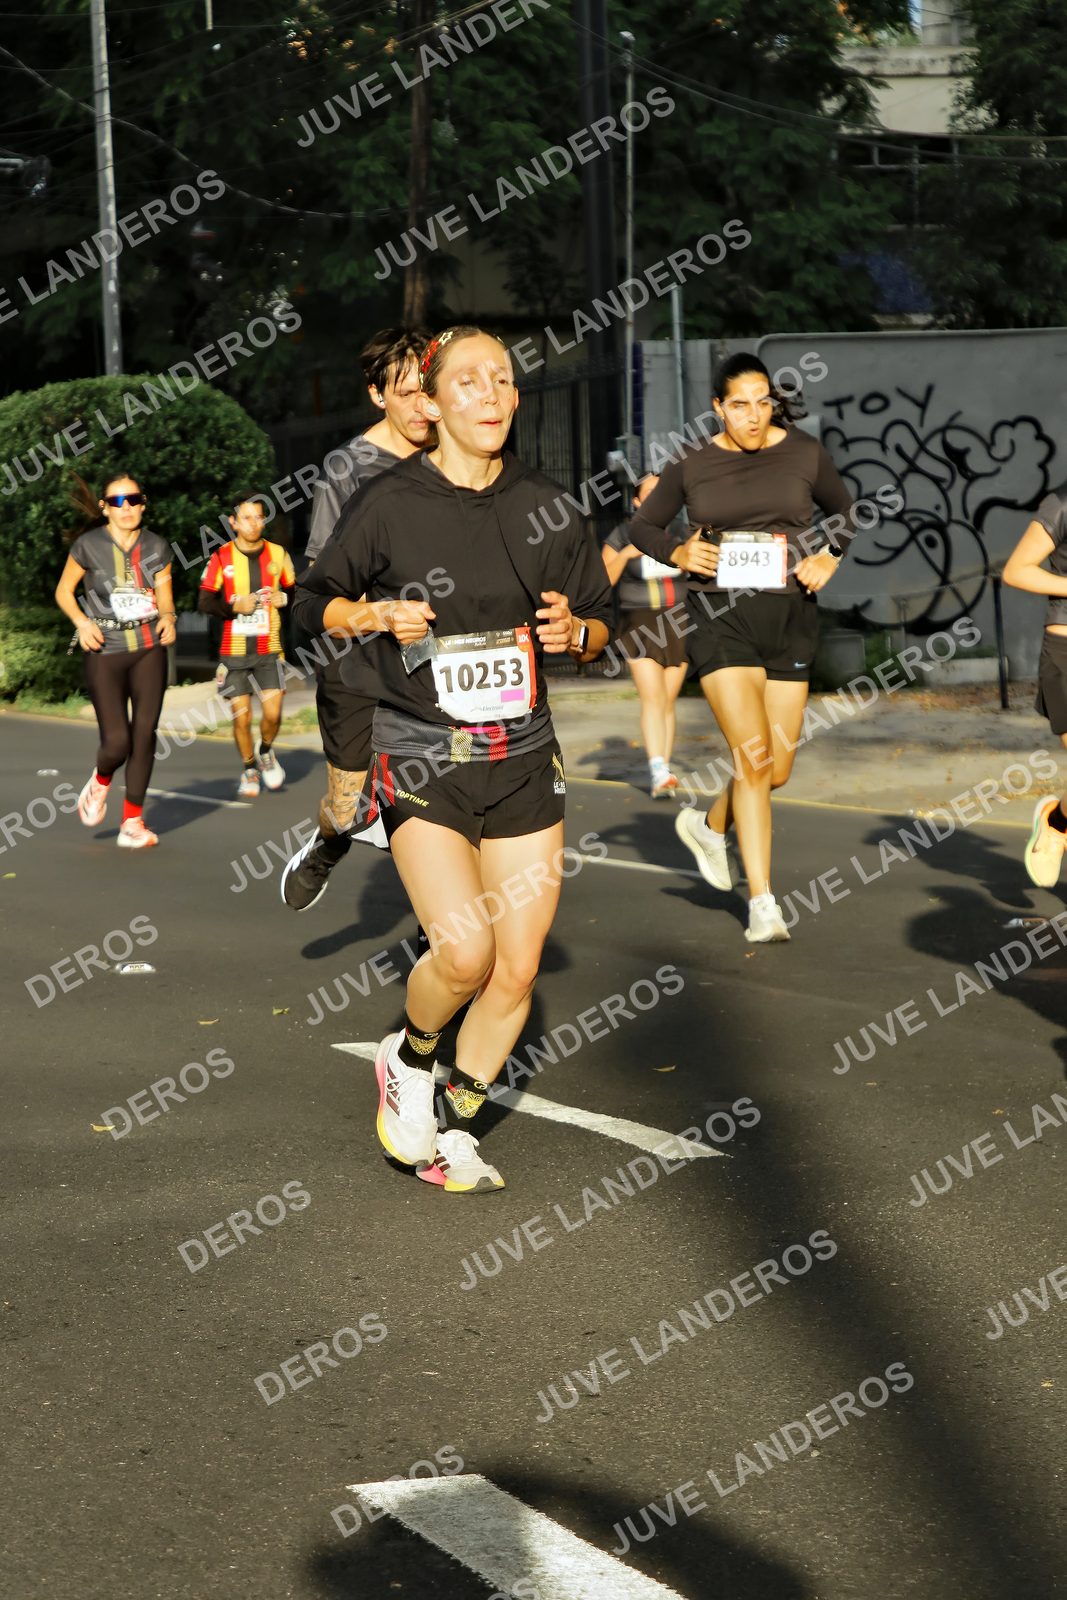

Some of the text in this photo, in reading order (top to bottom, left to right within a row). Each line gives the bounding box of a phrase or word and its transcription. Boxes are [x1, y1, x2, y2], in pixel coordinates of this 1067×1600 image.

[823, 383, 935, 427] TOY
[439, 657, 524, 693] 10253
[396, 788, 430, 808] TOPTIME
